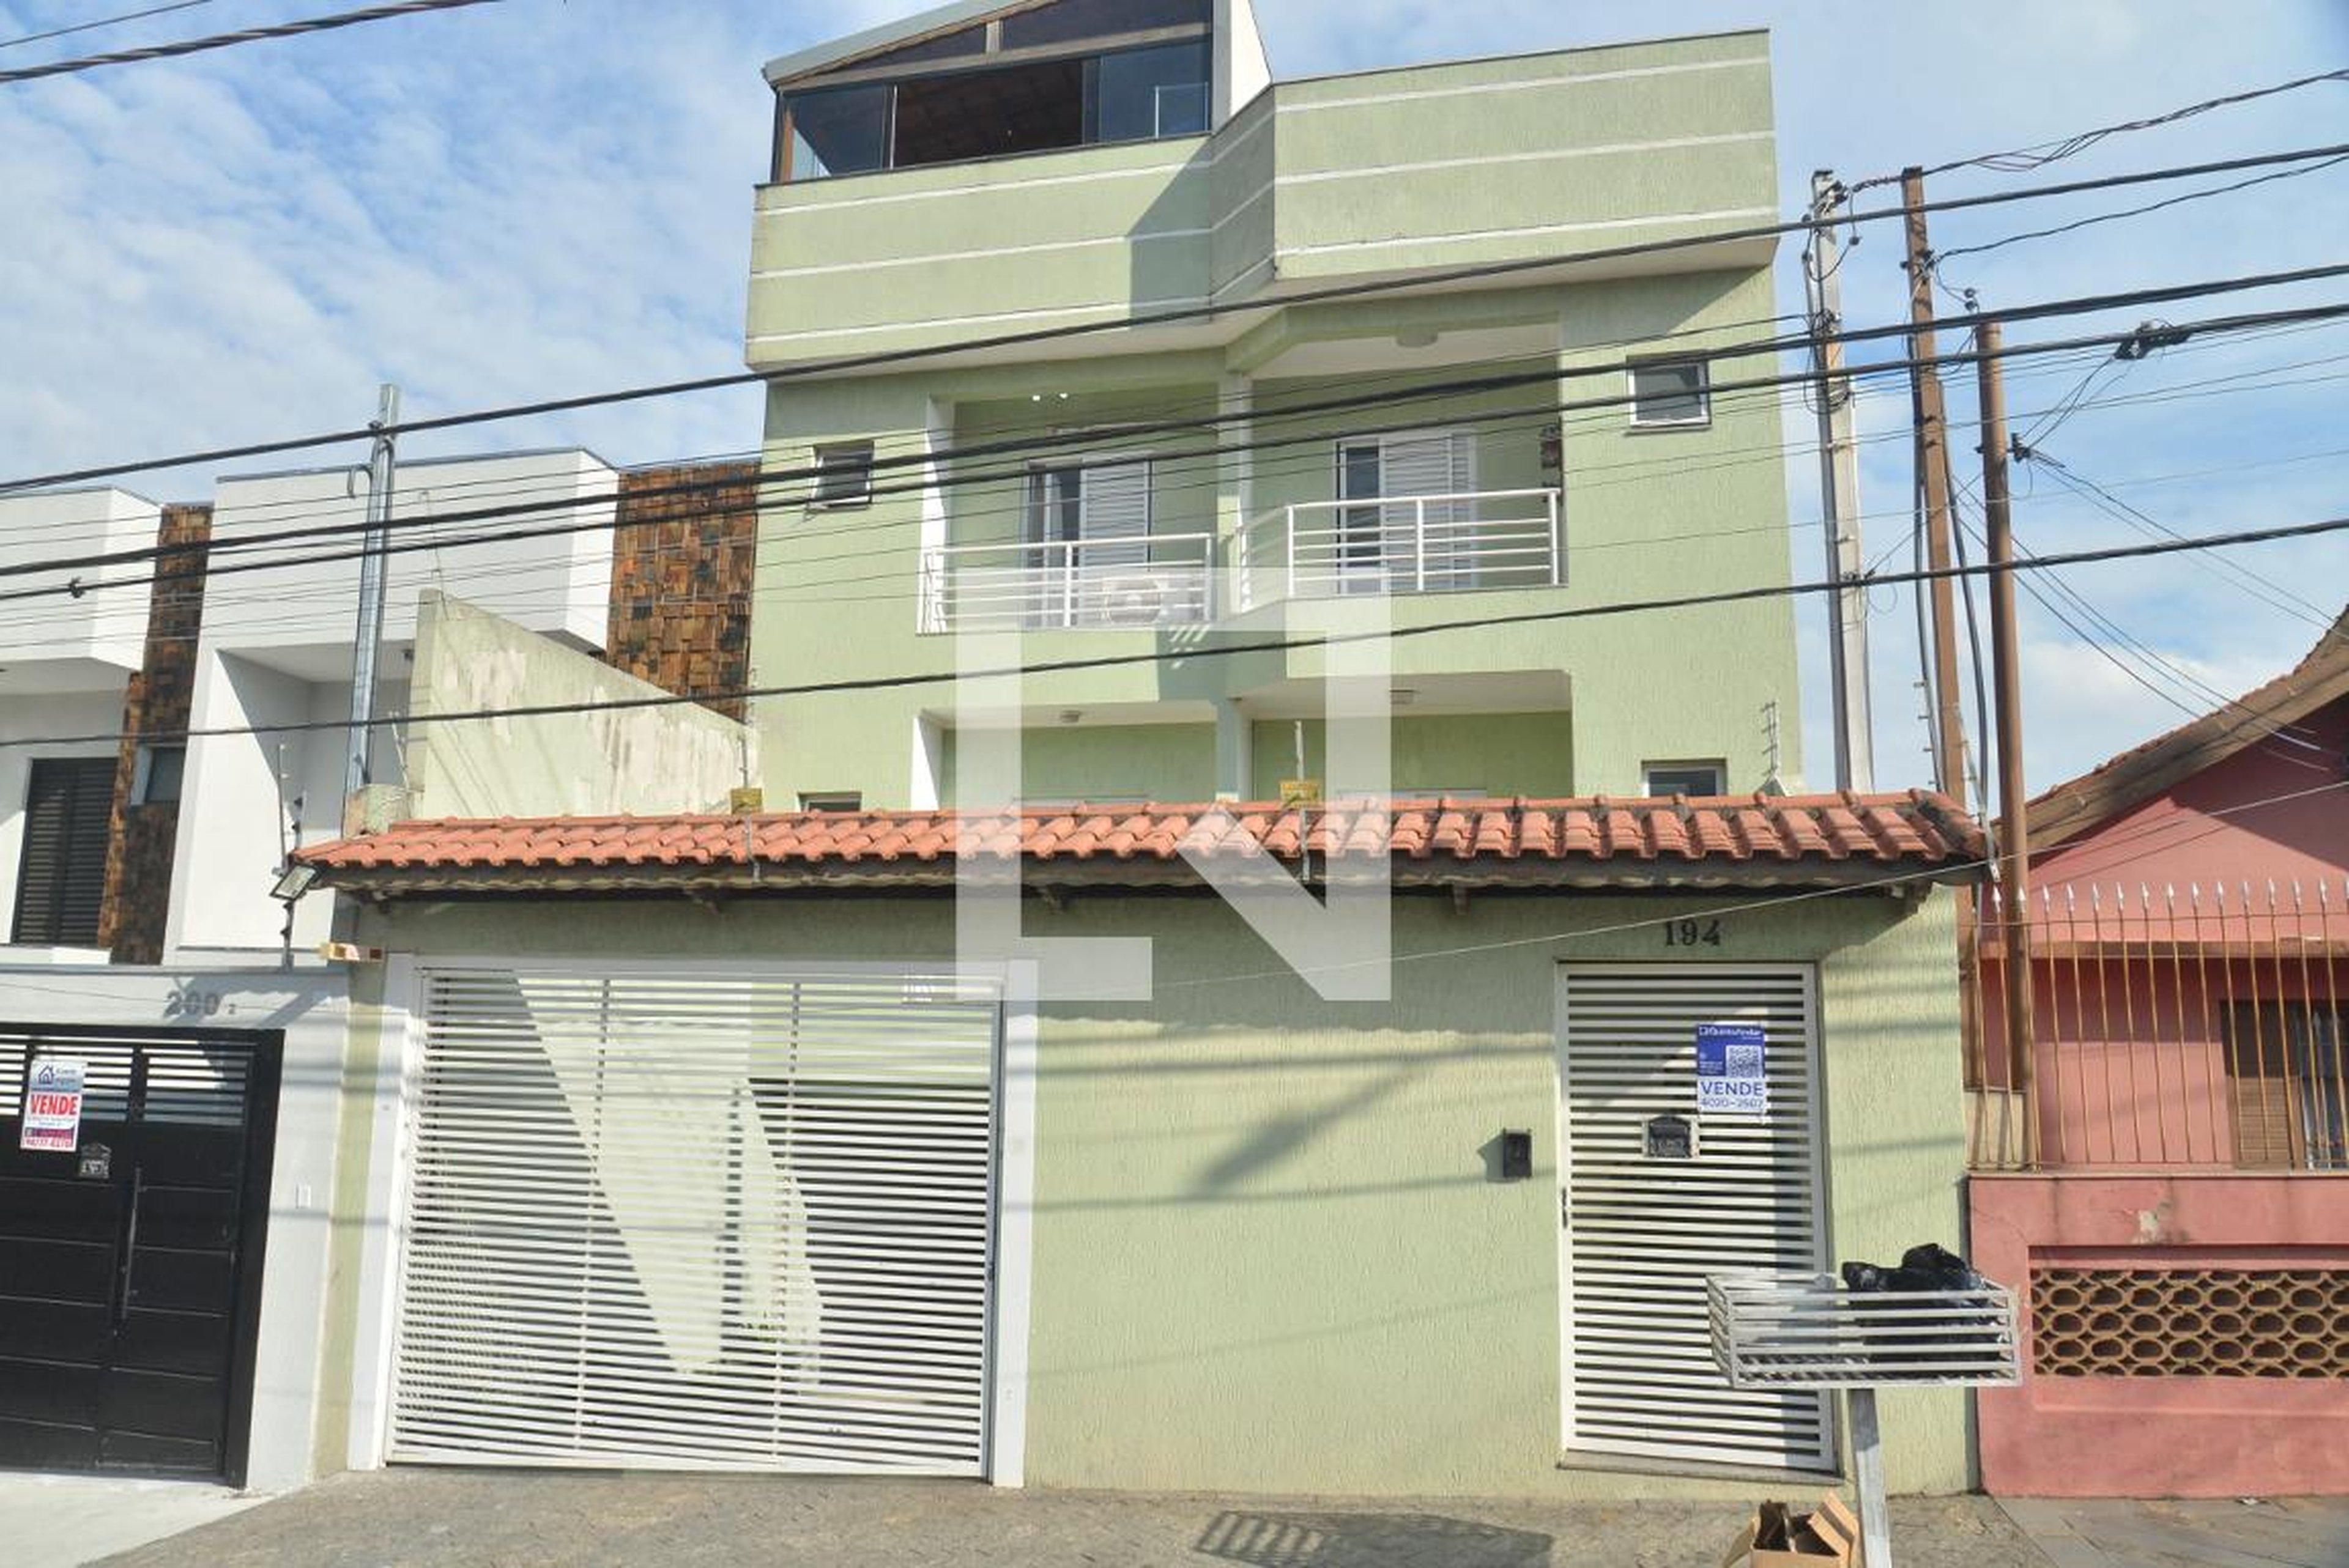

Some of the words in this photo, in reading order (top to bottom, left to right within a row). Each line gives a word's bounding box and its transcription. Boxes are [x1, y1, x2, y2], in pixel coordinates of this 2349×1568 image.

[1664, 918, 1721, 947] 194
[1700, 1081, 1764, 1096] VENDE
[31, 1093, 79, 1116] VENDE
